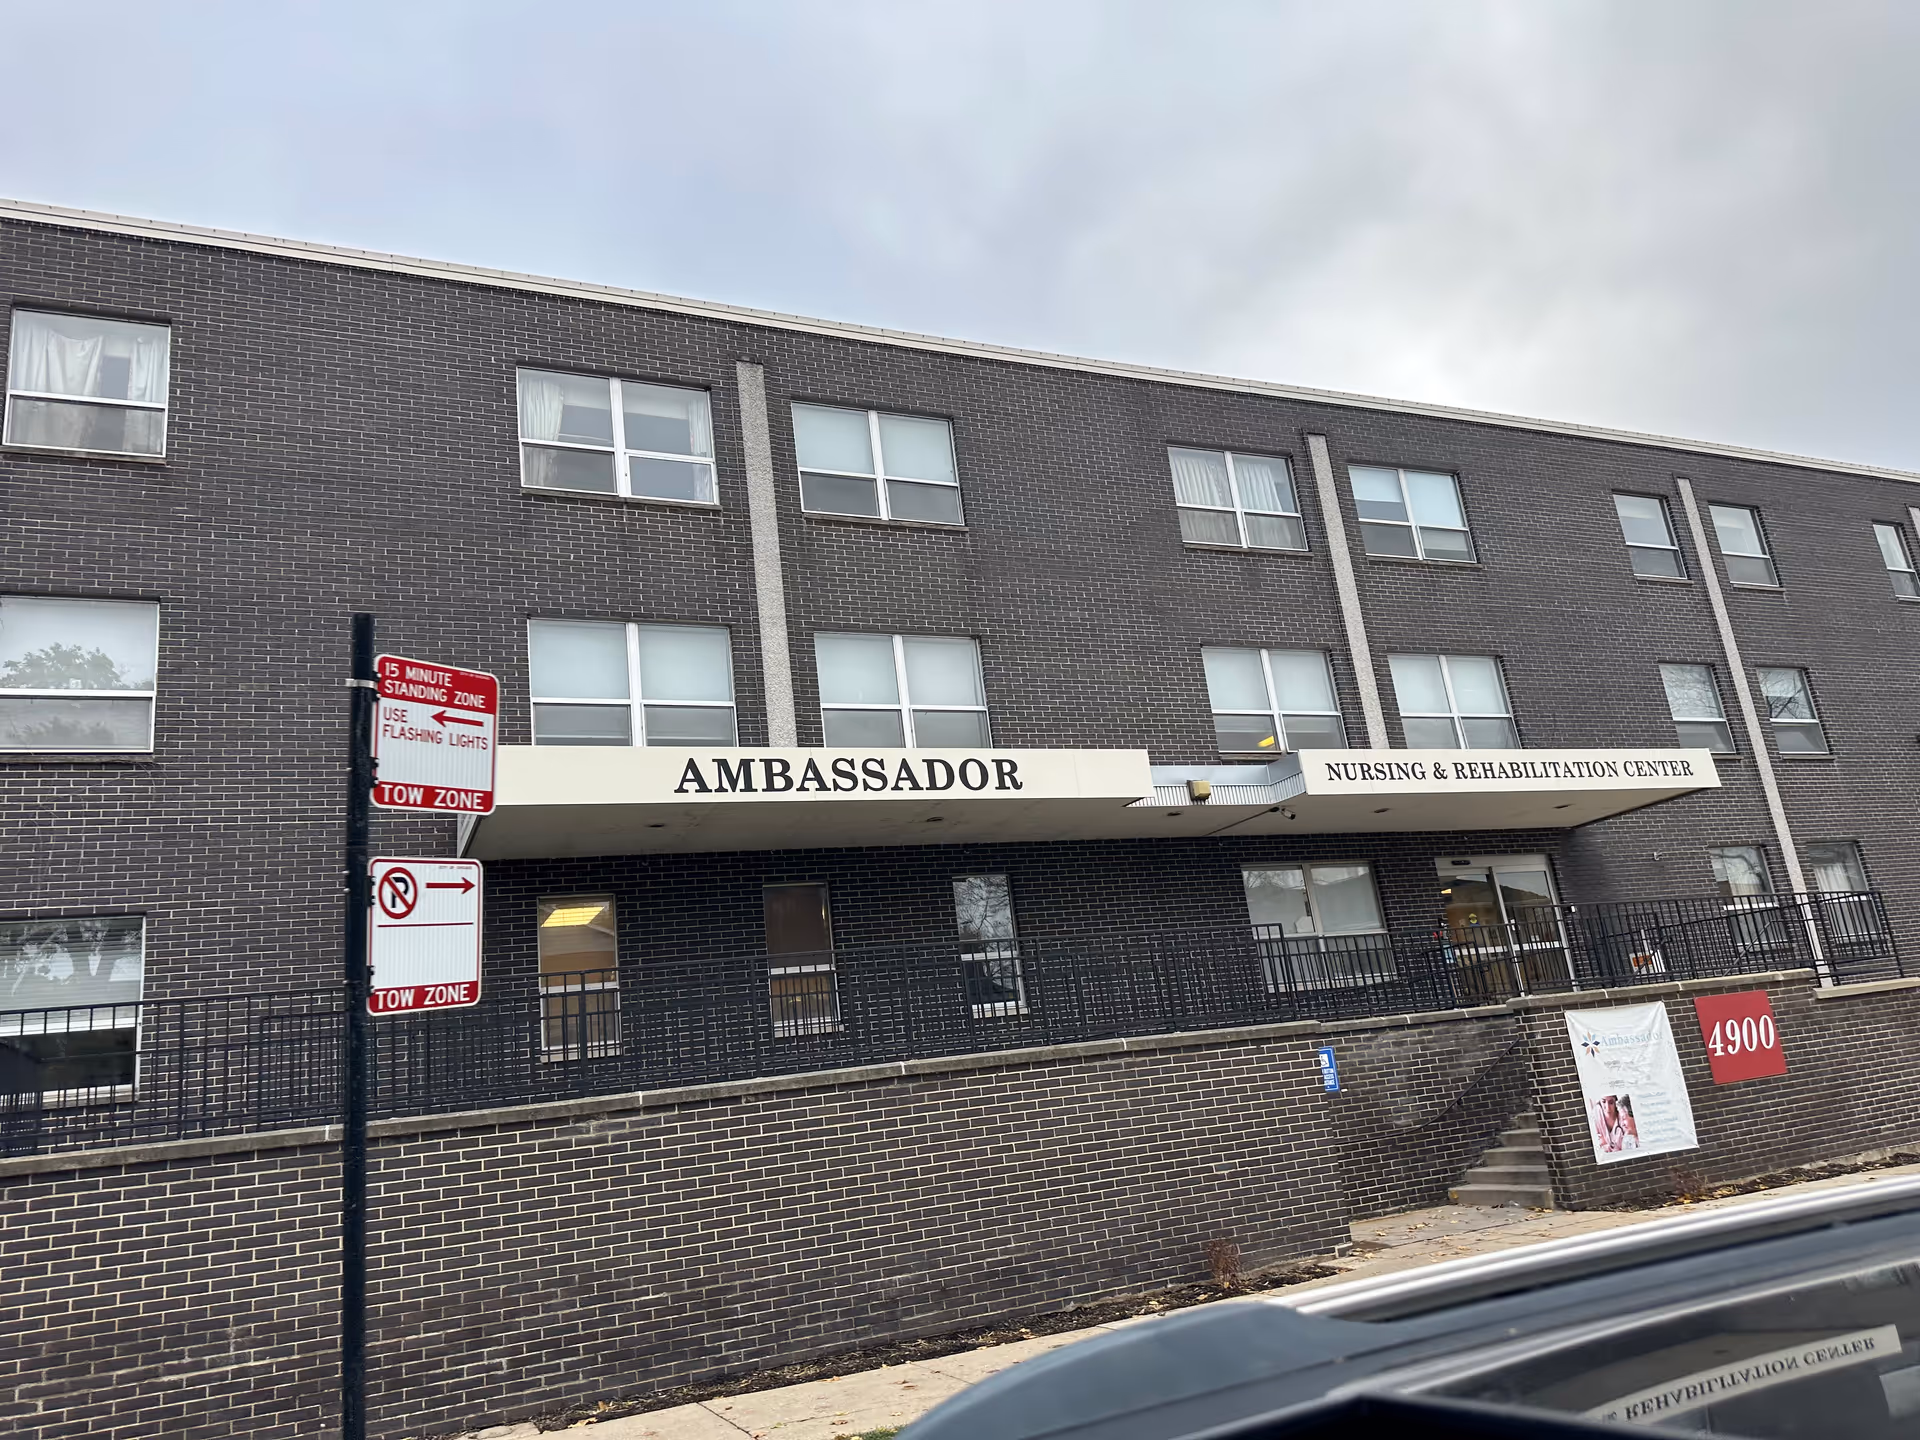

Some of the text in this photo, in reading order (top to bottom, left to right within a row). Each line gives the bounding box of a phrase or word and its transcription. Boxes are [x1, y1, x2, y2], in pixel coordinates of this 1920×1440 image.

[384, 662, 400, 678] 15
[405, 665, 453, 687] MINUTE
[384, 679, 487, 709] STANDING ZONE
[383, 706, 408, 723] USE
[382, 723, 489, 751] FLASHING LIGHTS
[673, 757, 1024, 794] AMBASSADOR
[1325, 759, 1694, 781] NURSING & REHABILITATION CENTER
[381, 784, 485, 810] TOW ZONE
[375, 983, 470, 1010] TOW ZONE
[1600, 1031, 1663, 1047] Ambassador
[1708, 1013, 1776, 1057] 4900
